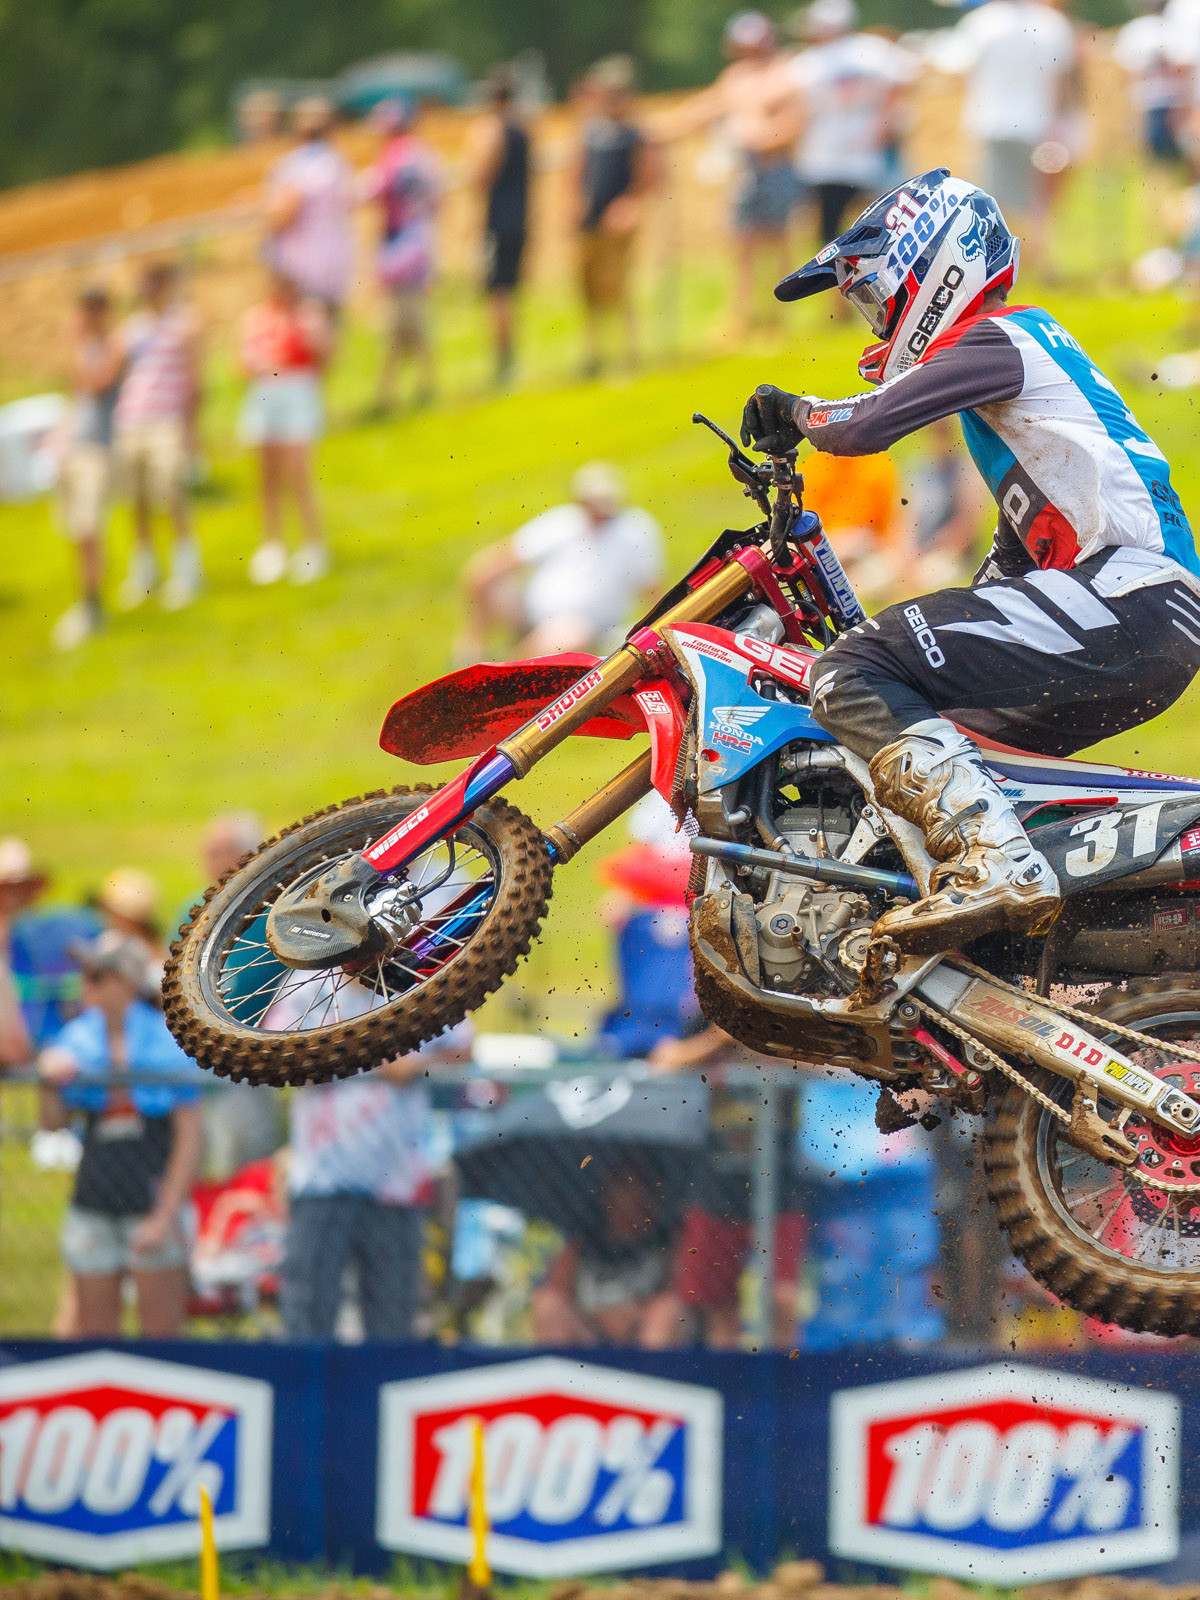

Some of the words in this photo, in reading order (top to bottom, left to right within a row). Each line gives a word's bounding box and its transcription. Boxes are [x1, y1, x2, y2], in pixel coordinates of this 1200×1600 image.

[884, 190, 924, 236] 31
[817, 243, 839, 265] 100%
[907, 264, 966, 356] GEICO
[806, 406, 855, 429] AMSOIL
[903, 604, 946, 669] GEICO
[536, 670, 603, 732] SHOWA
[708, 721, 765, 746] HONDA
[711, 732, 752, 755] HRC
[1065, 801, 1167, 877] 31
[971, 996, 1058, 1038] AMSOIL
[0, 1403, 224, 1517] 100%
[430, 1412, 676, 1527] 100%
[880, 1417, 1136, 1534] 100%
